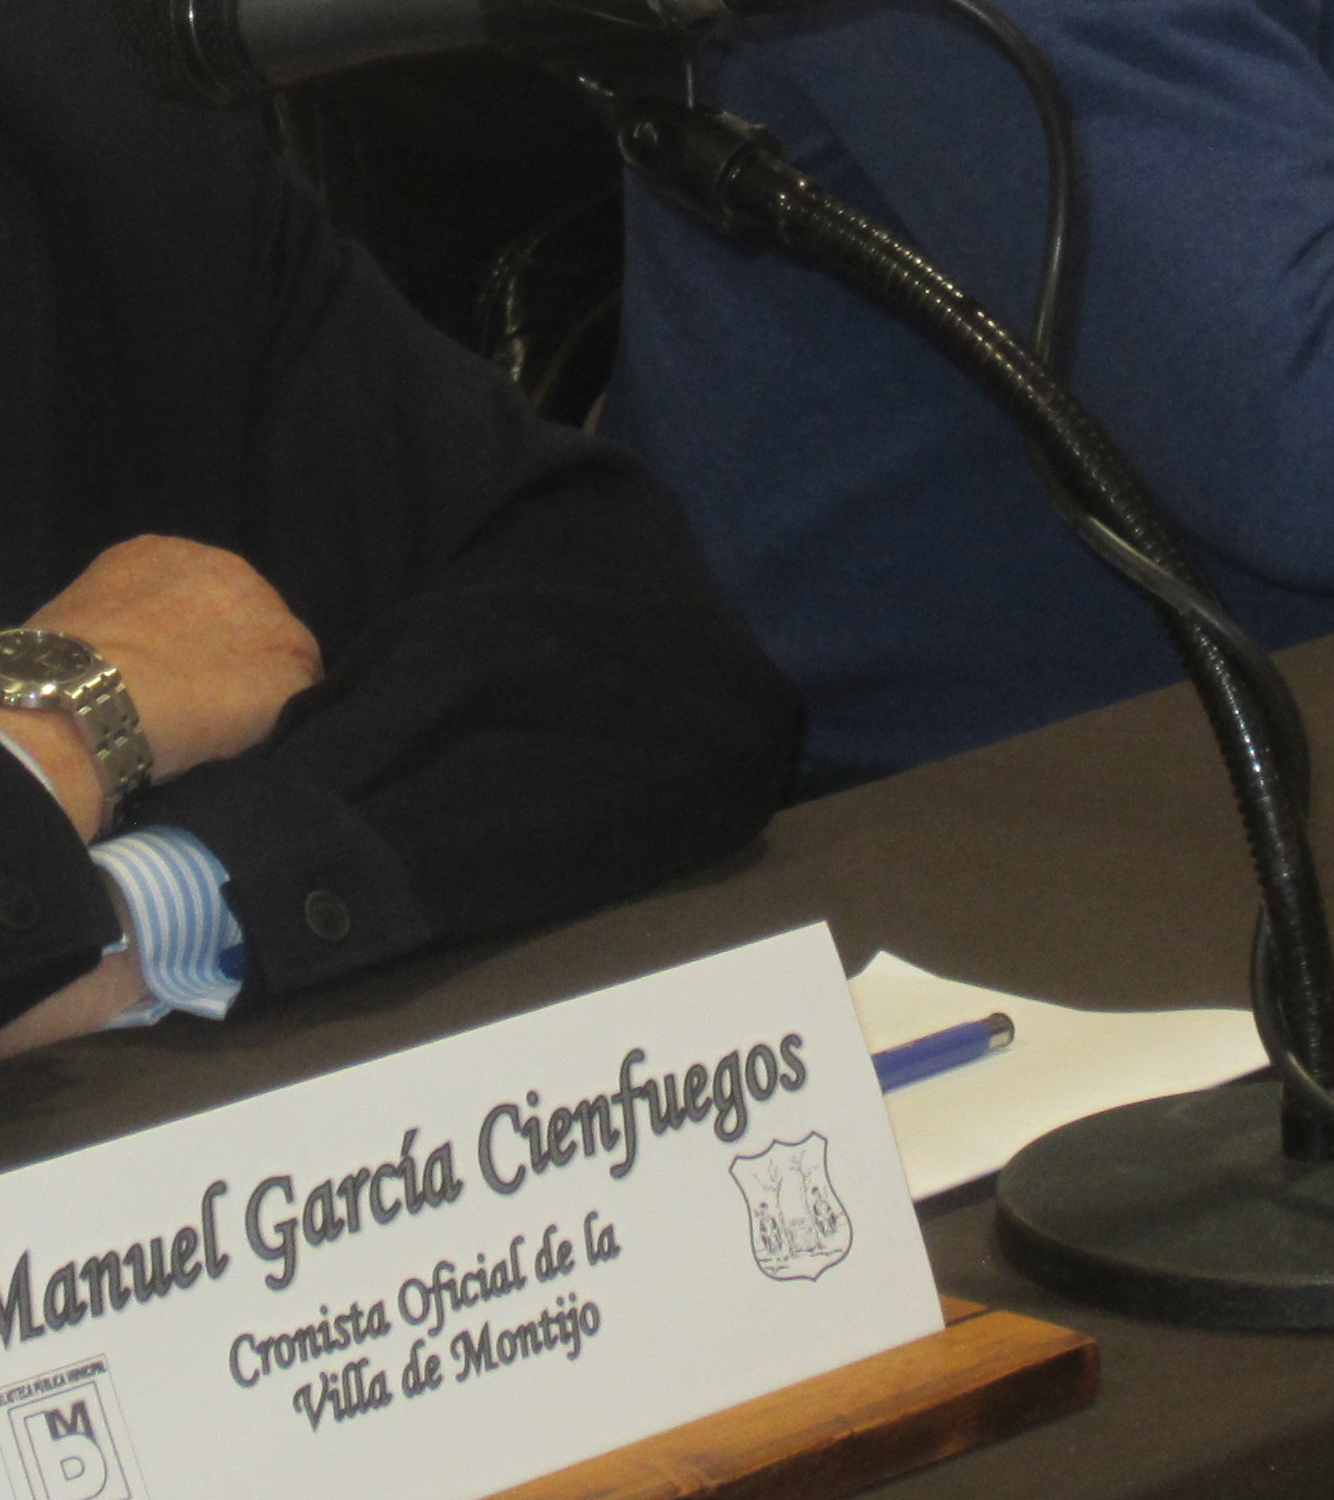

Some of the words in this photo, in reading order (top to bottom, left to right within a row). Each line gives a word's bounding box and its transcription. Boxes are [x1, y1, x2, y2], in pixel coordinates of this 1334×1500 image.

[244, 1127, 465, 1292] García
[477, 1032, 808, 1196] Cienfuegos
[228, 1299, 392, 1388] Cronista
[397, 1235, 527, 1337] Oficial
[534, 1223, 576, 1284] de
[583, 1209, 622, 1267] la
[292, 1357, 395, 1433] Villa
[401, 1338, 444, 1399] de
[450, 1292, 602, 1383] Montijo
